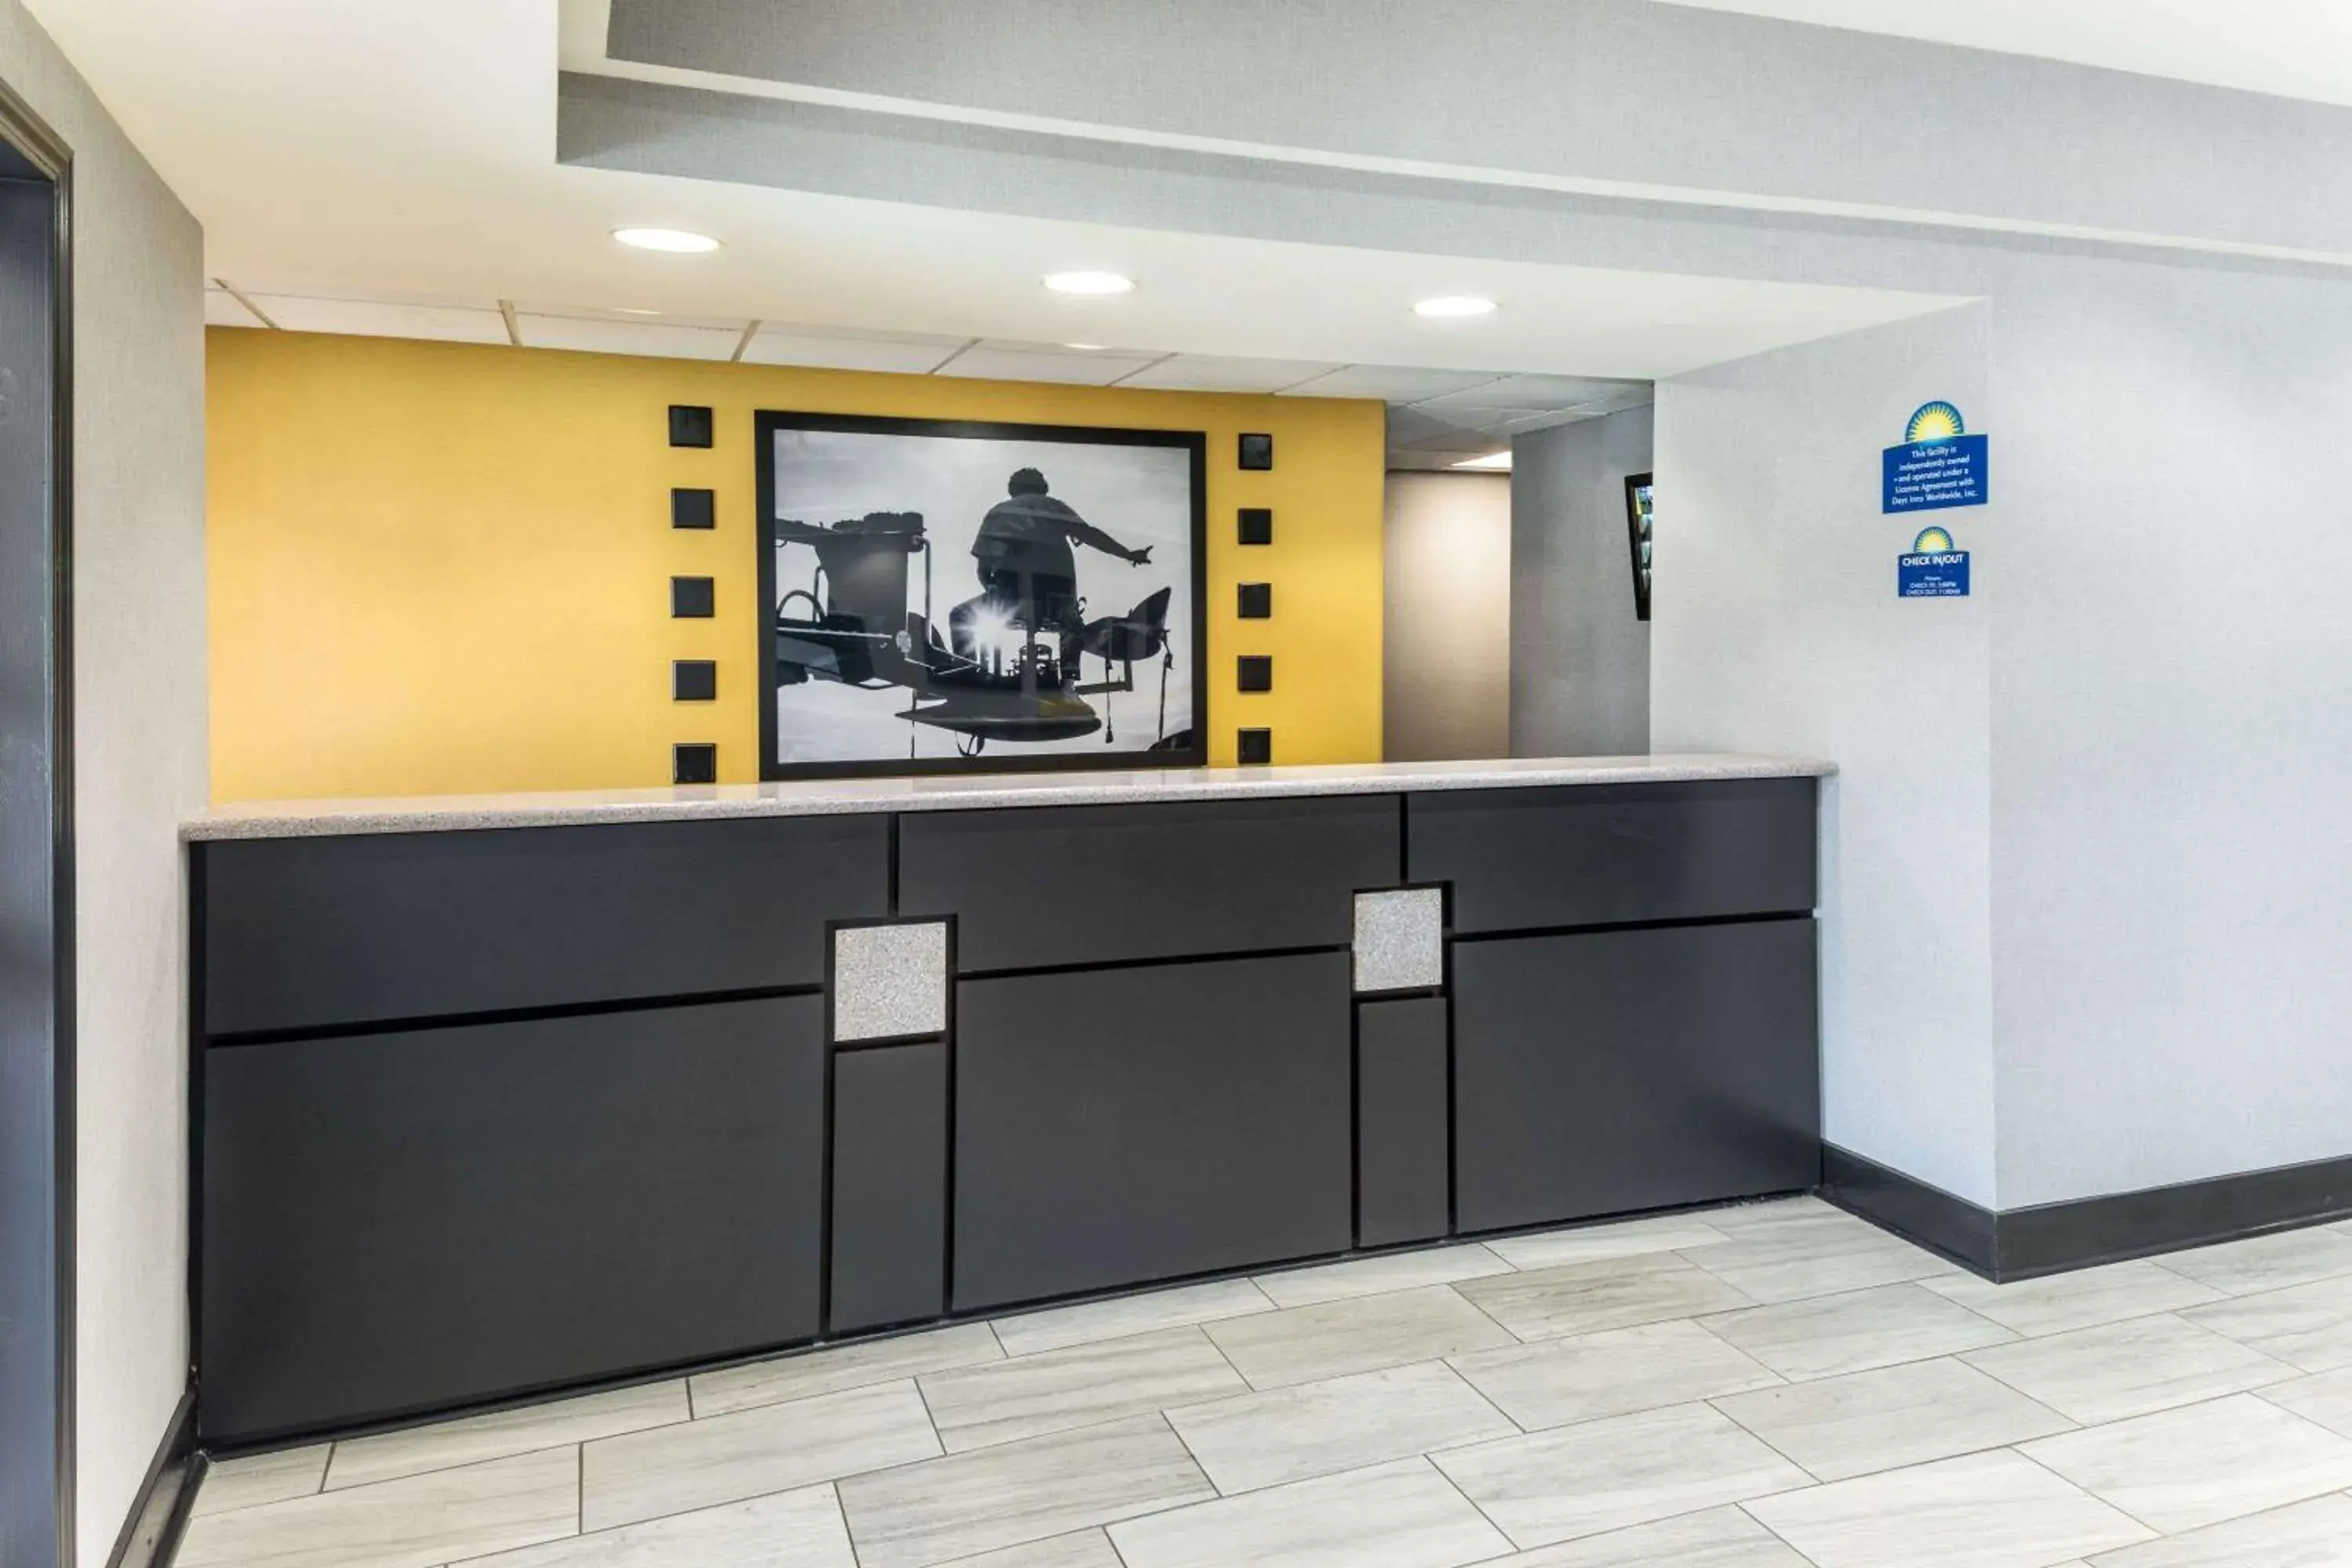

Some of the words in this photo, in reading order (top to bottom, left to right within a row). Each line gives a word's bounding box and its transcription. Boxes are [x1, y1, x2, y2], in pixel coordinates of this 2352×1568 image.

[1912, 449, 1926, 458] This
[1927, 447, 1949, 456] facility
[1951, 445, 1957, 454] is
[1899, 459, 1944, 470] independently
[1947, 455, 1970, 465] owned
[1911, 471, 1941, 481] operated
[1943, 468, 1962, 477] under
[1895, 485, 1919, 493] License
[1921, 481, 1958, 492] Agreement
[1958, 477, 1975, 486] with
[1892, 496, 1907, 506] Days
[1903, 556, 1931, 566] CHECK
[1932, 554, 1963, 567] IN/OUT
